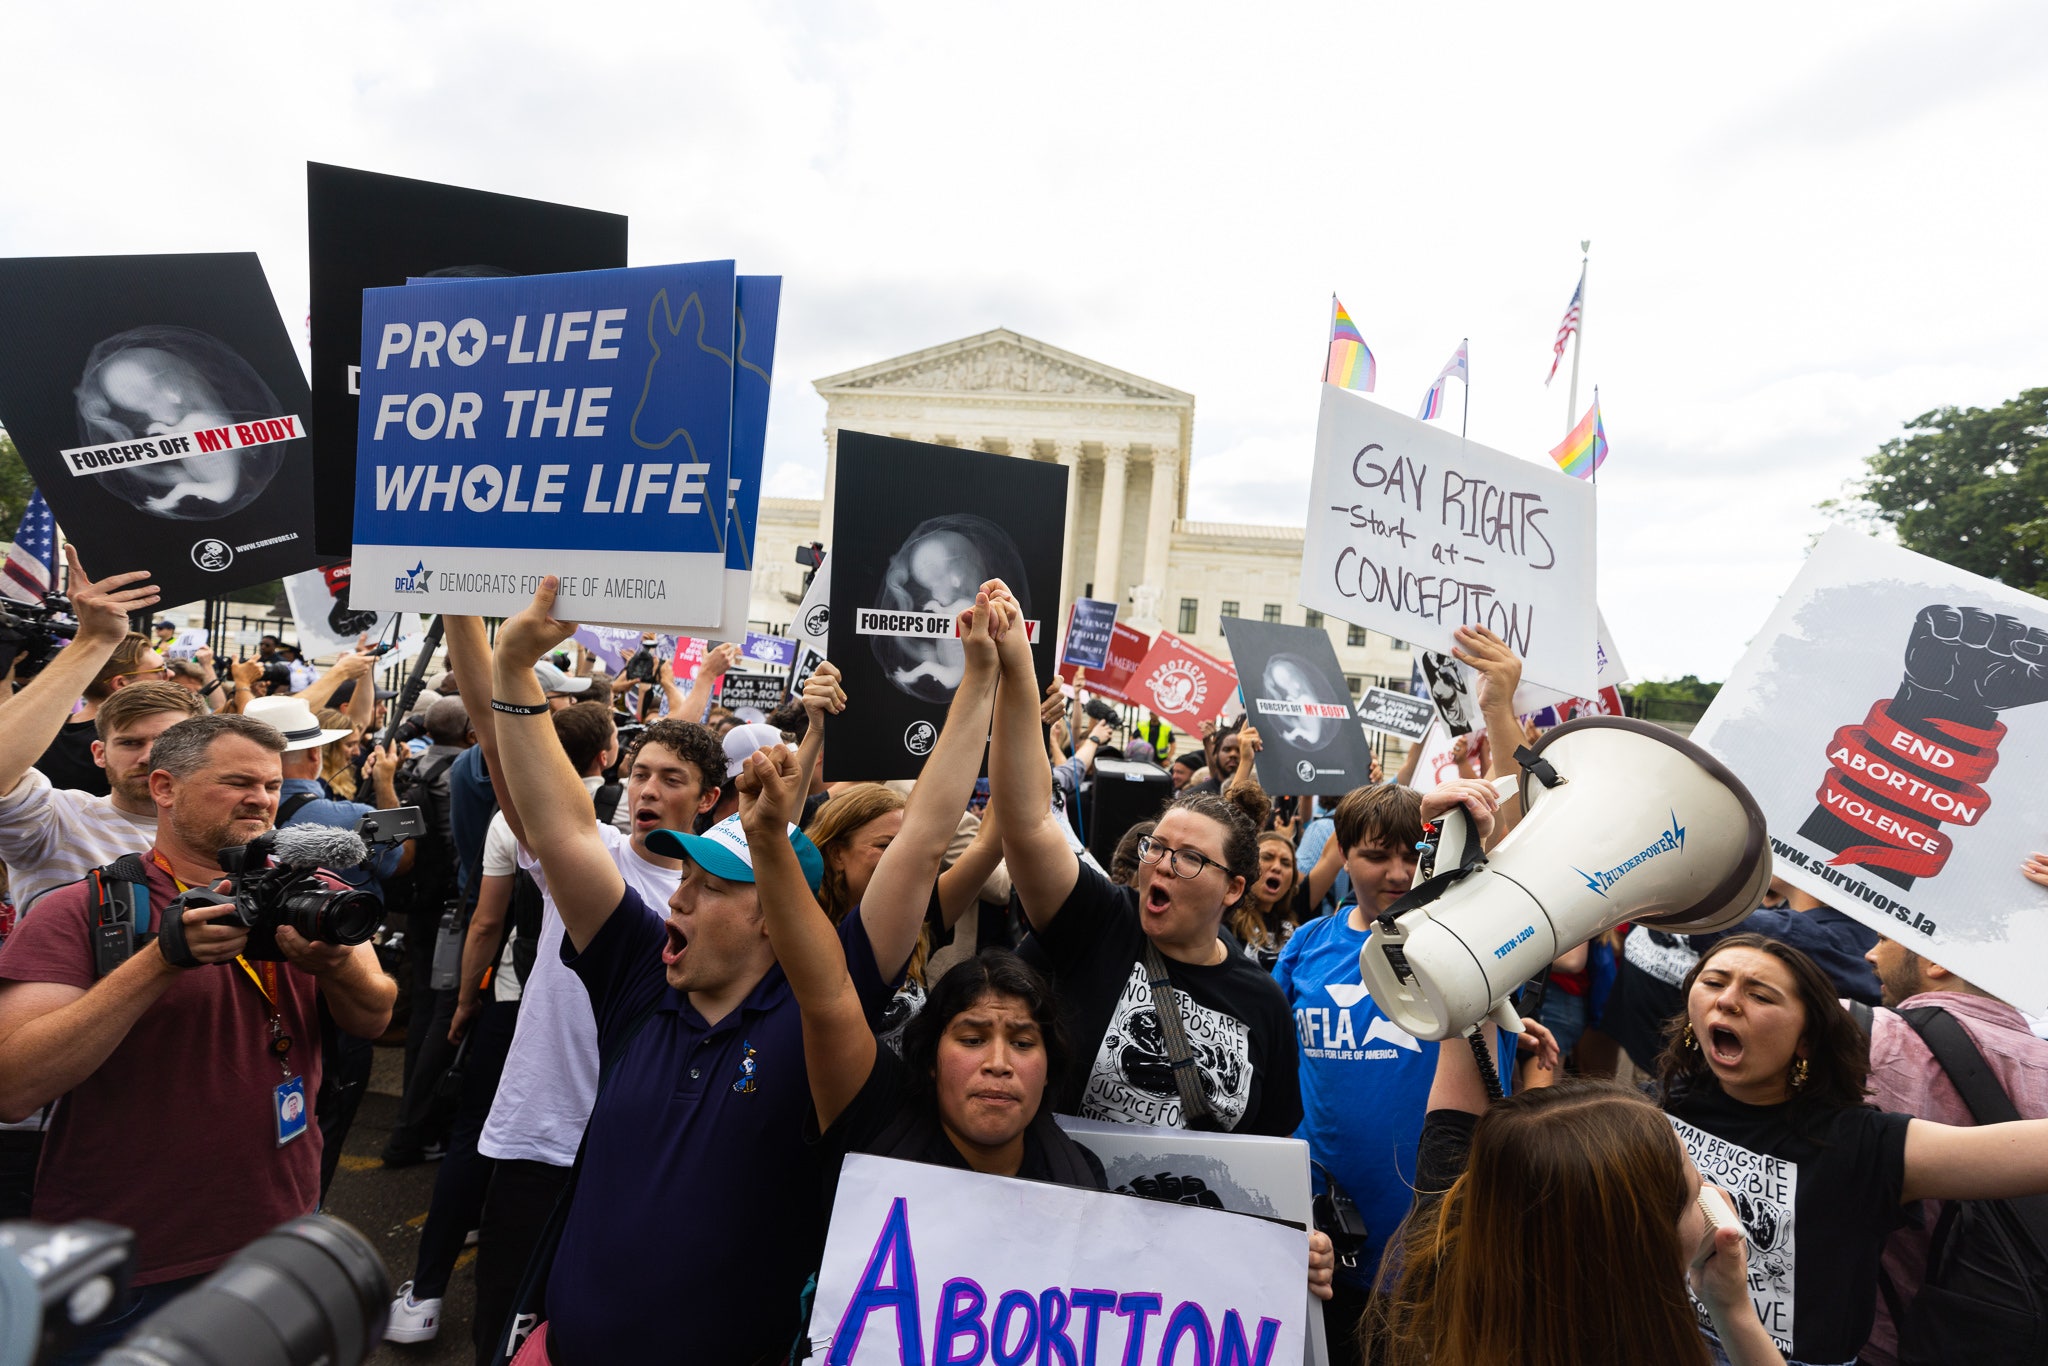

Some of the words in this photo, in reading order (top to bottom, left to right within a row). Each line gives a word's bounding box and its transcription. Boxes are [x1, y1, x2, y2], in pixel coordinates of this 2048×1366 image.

[376, 308, 627, 370] PRO-LIFE
[374, 391, 482, 441] FOR
[502, 386, 613, 438] THE
[70, 442, 158, 471] FORCEPS
[158, 436, 190, 456] OFF
[194, 426, 234, 453] MY
[234, 417, 297, 446] BODY
[375, 463, 569, 513] WHOLE
[582, 463, 711, 514] LIFE
[1352, 443, 1427, 512] GAY
[1441, 470, 1555, 569] RIGHTS
[235, 532, 299, 553] WWW.SURVIVORS.LA
[394, 577, 415, 591] DFLA
[440, 572, 516, 594] DEMOCRATS
[556, 576, 577, 597] IFE
[582, 577, 599, 598] OF
[604, 578, 666, 600] AMERICA
[861, 613, 924, 633] FORCEPS
[926, 617, 950, 634] OFF
[735, 680, 754, 688] AM
[759, 681, 780, 690] THE
[1152, 659, 1208, 705] PROTECTION
[491, 701, 531, 714] PRO-BLACK
[1304, 703, 1319, 716] MY
[1320, 704, 1345, 718] BODY
[1357, 708, 1426, 735] ABORTION
[1890, 729, 1955, 770] END
[1829, 745, 1978, 824] ABORTION
[1824, 789, 1941, 856] VIOLENCE
[1593, 829, 1679, 892] THUNDERPOWER
[1337, 1050, 1353, 1060] LIFE
[1353, 1050, 1363, 1060] OF
[1364, 1049, 1399, 1060] AMERICA
[1091, 1079, 1156, 1117] JUSTICE
[1687, 1143, 1788, 1205] DISPOSABLE
[1707, 1138, 1758, 1171] BEINGS
[827, 1196, 1282, 1366] ABORTION
